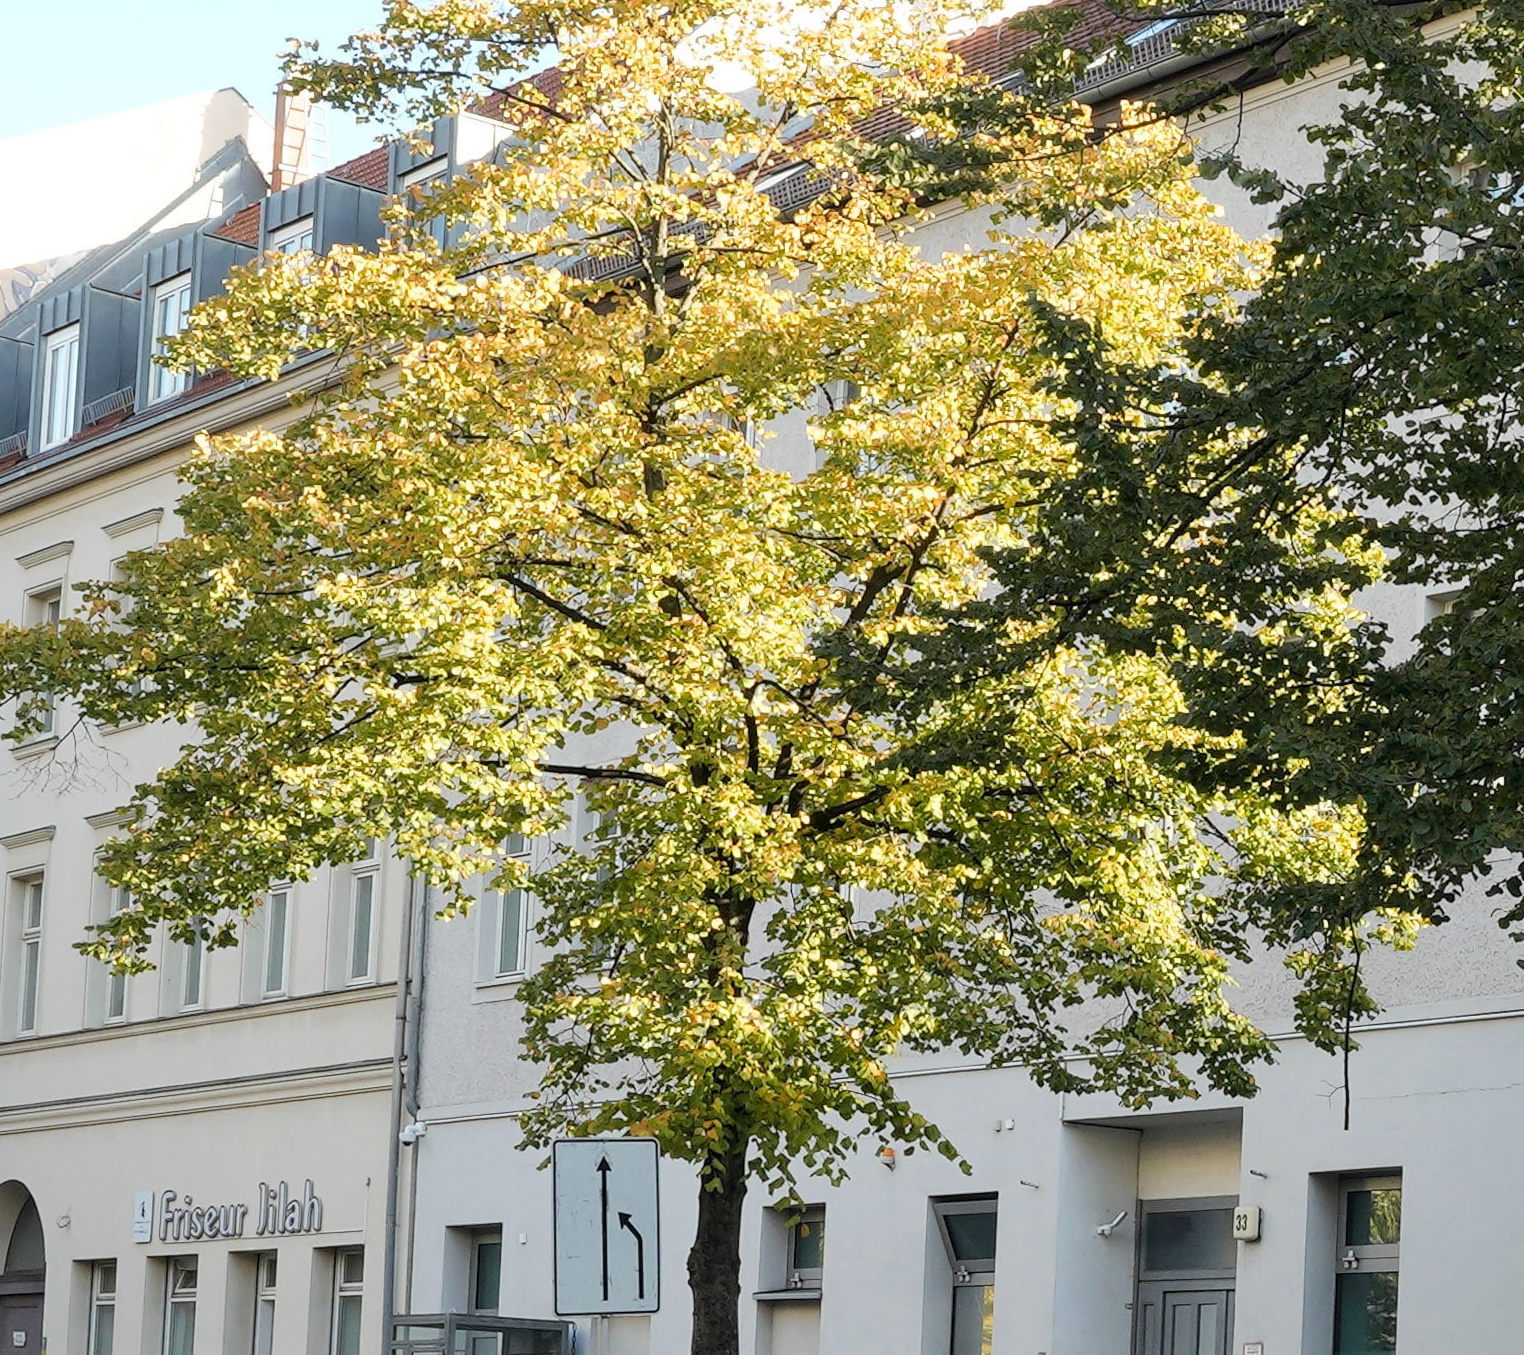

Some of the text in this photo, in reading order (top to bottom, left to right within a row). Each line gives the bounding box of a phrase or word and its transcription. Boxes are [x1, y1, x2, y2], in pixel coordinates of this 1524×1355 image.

[159, 1178, 322, 1241] Friseur Jilah
[1235, 1213, 1248, 1231] 33
